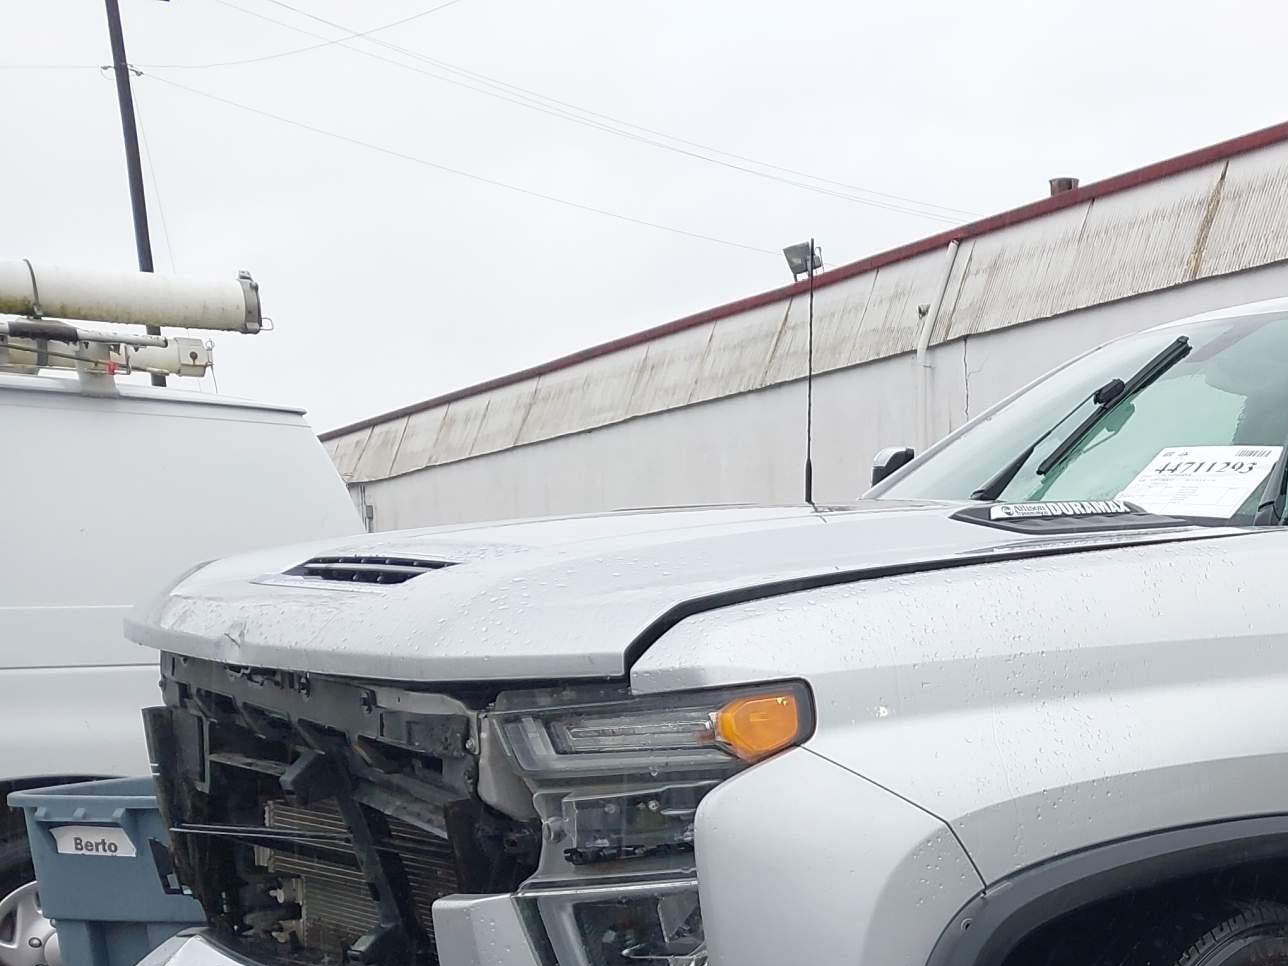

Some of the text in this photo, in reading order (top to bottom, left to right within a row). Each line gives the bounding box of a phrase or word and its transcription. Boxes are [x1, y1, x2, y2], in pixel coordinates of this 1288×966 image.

[1154, 461, 1257, 474] 44711293
[1047, 500, 1131, 516] DURAMAX
[73, 836, 118, 853] Berto
